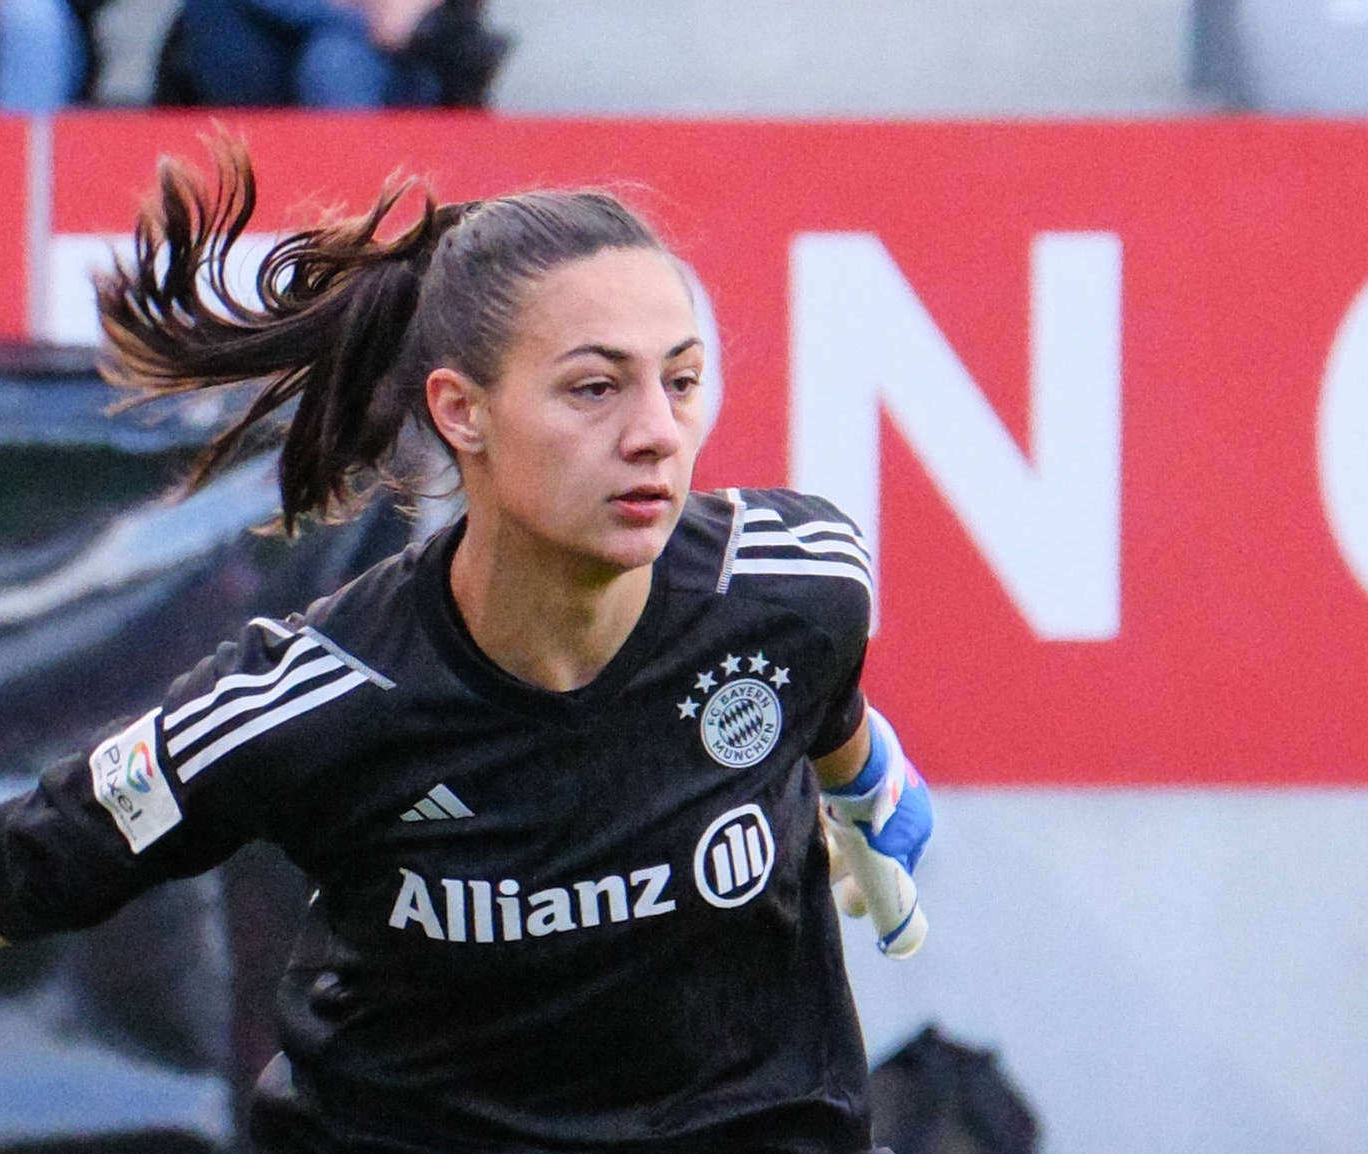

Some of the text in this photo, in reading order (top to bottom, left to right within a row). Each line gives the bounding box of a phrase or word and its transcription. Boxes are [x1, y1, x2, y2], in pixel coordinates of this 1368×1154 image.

[719, 686, 771, 709] BAYERN
[102, 744, 144, 822] Pixel
[387, 863, 677, 944] Allianz
